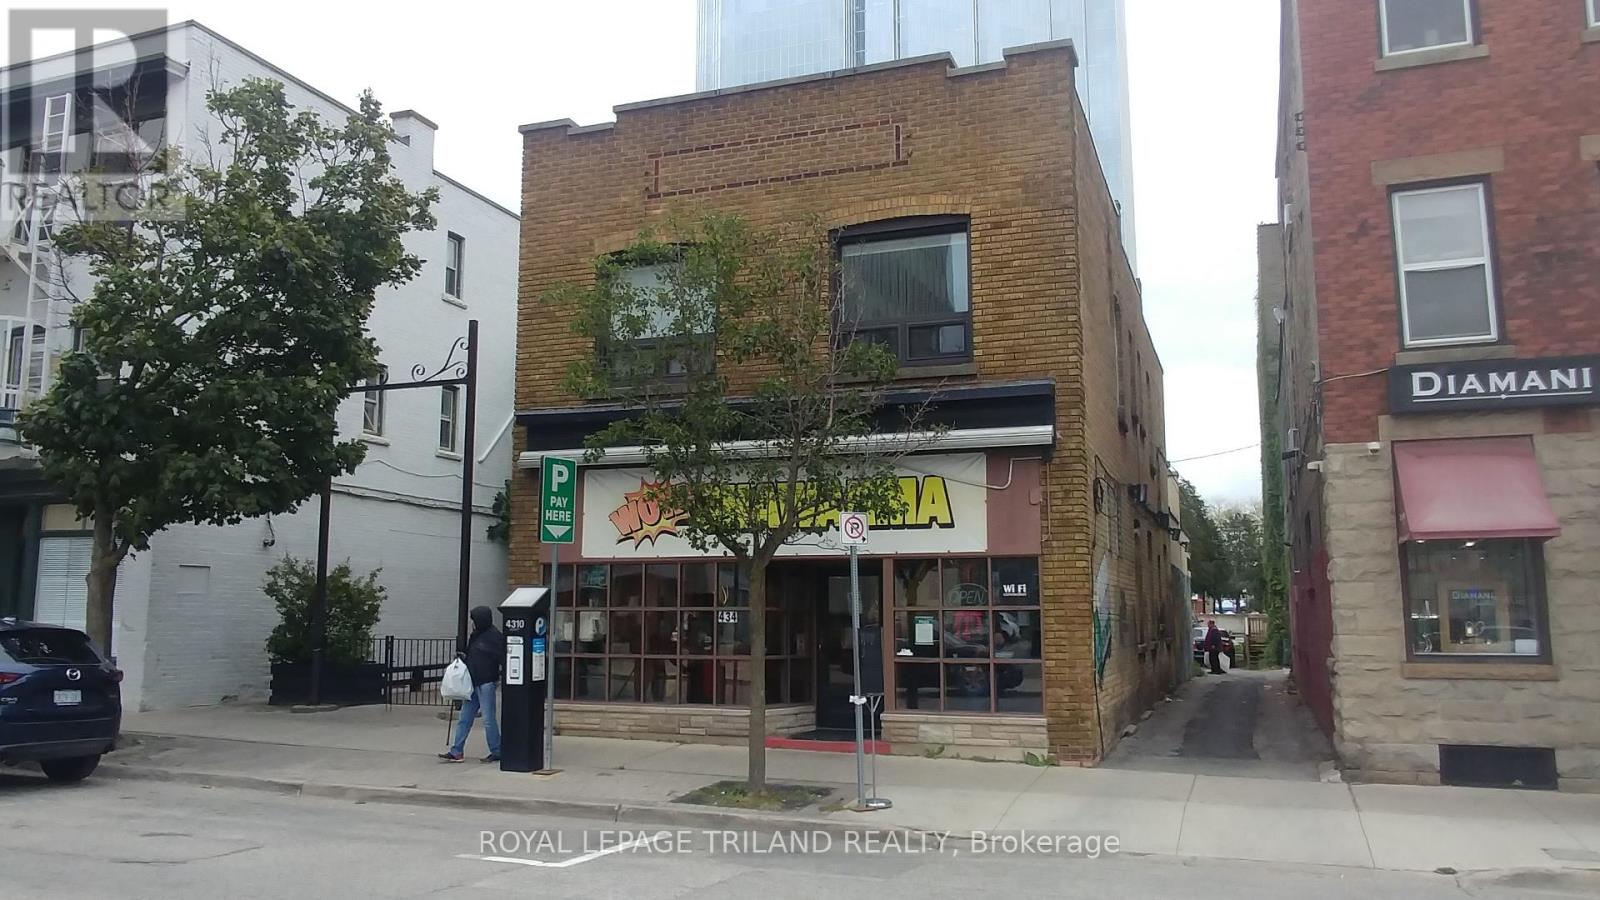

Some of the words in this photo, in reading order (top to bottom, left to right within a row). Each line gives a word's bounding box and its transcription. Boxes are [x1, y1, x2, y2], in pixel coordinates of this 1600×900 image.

[1411, 367, 1591, 397] DIAMANI
[552, 464, 569, 492] P
[550, 496, 567, 508] PAY
[545, 510, 571, 522] HERE
[718, 611, 737, 623] 434
[505, 619, 525, 629] 4310
